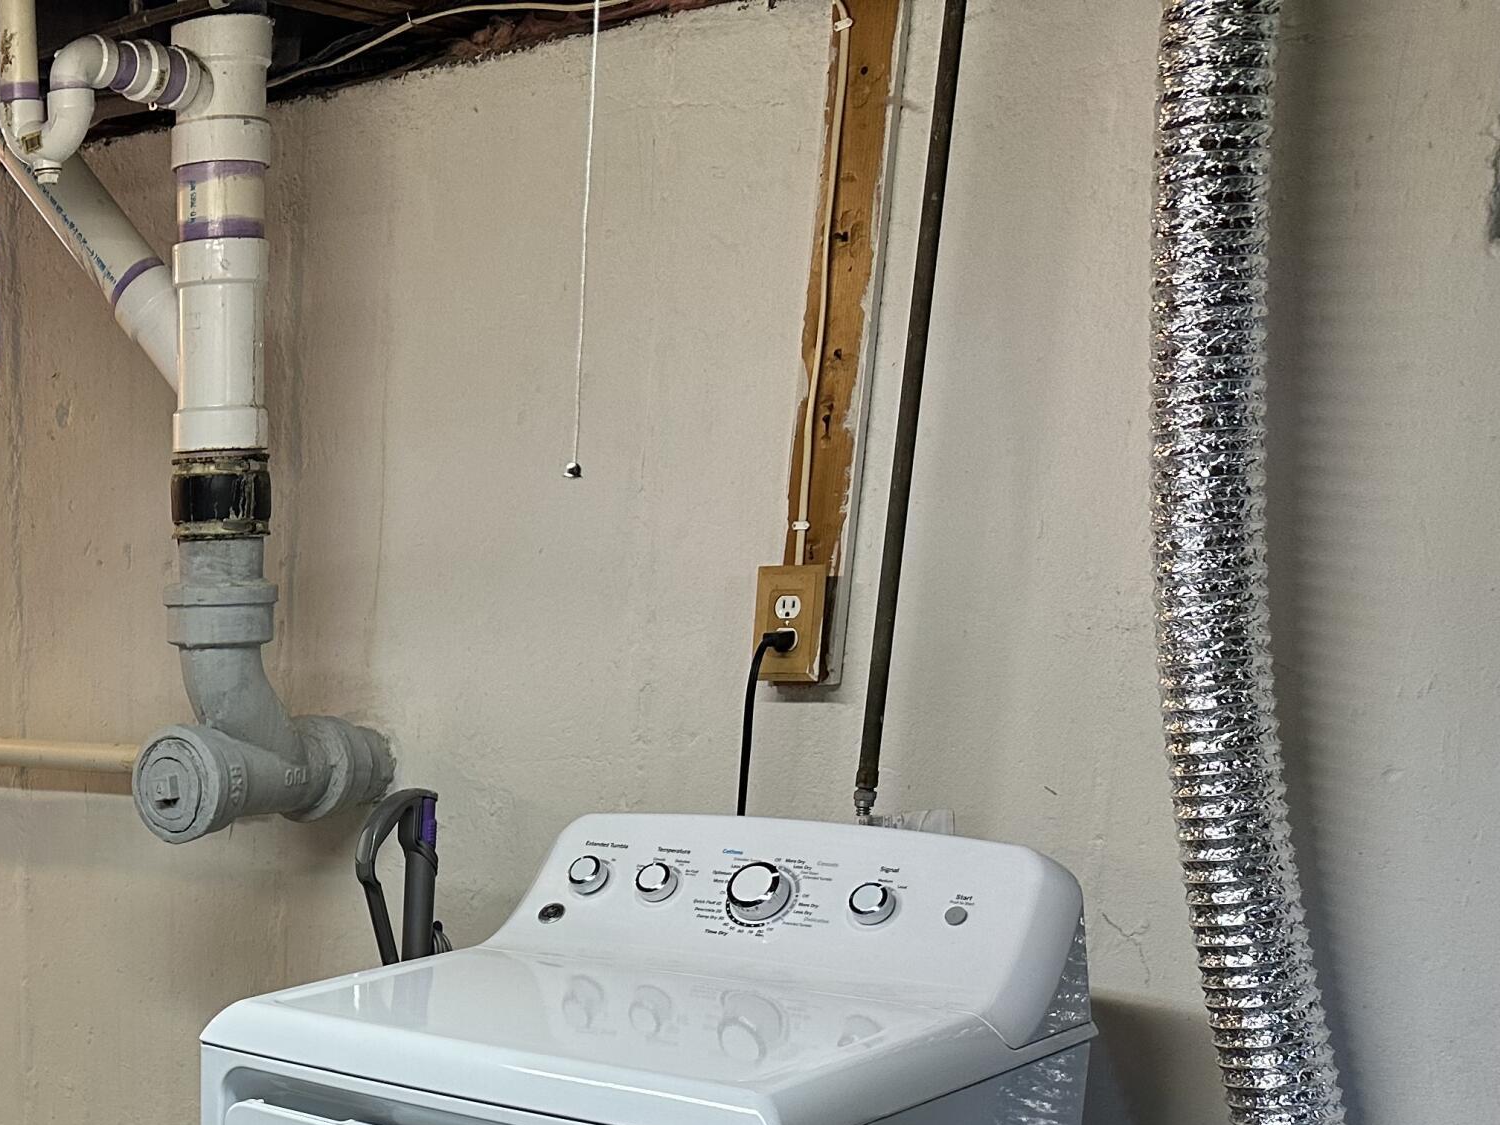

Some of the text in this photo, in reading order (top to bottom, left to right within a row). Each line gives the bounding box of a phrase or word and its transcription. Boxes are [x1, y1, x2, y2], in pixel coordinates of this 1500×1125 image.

[657, 846, 691, 855] Temperature
[880, 866, 900, 874] Signal
[955, 893, 973, 901] Start
